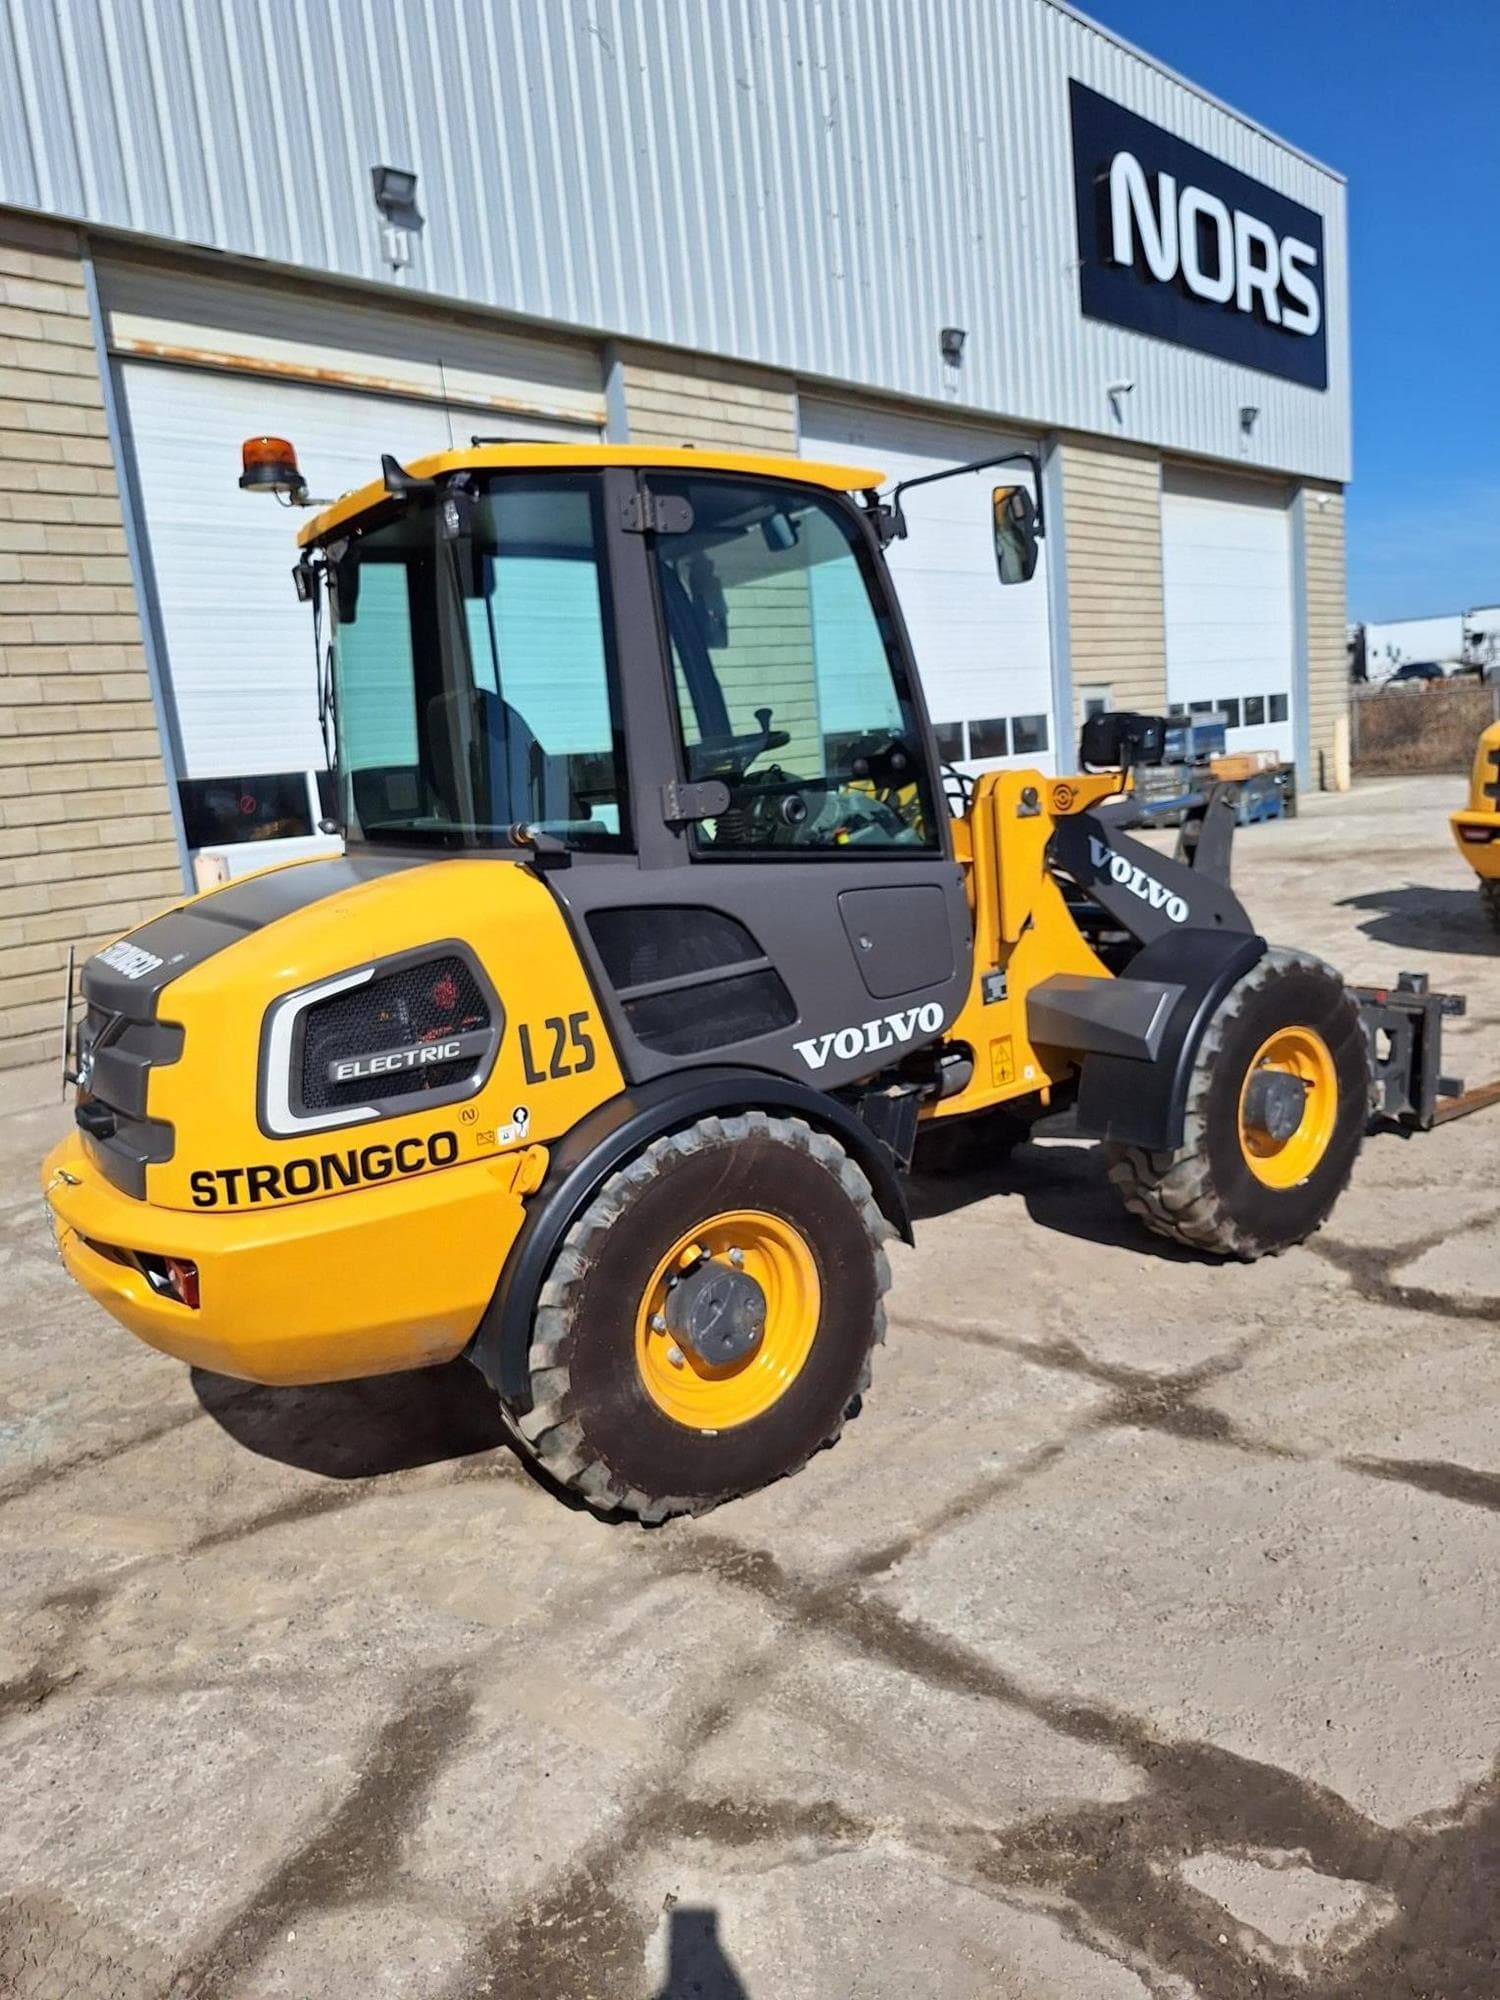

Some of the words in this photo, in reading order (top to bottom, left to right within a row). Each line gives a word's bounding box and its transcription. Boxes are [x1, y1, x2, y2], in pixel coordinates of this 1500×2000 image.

[1109, 151, 1320, 336] NORS
[1088, 834, 1189, 923] VOLVO
[336, 1042, 461, 1080] ELECTRIC
[518, 1011, 596, 1085] L25
[793, 1002, 944, 1069] VOLVO
[190, 1131, 458, 1207] STRONGCO
